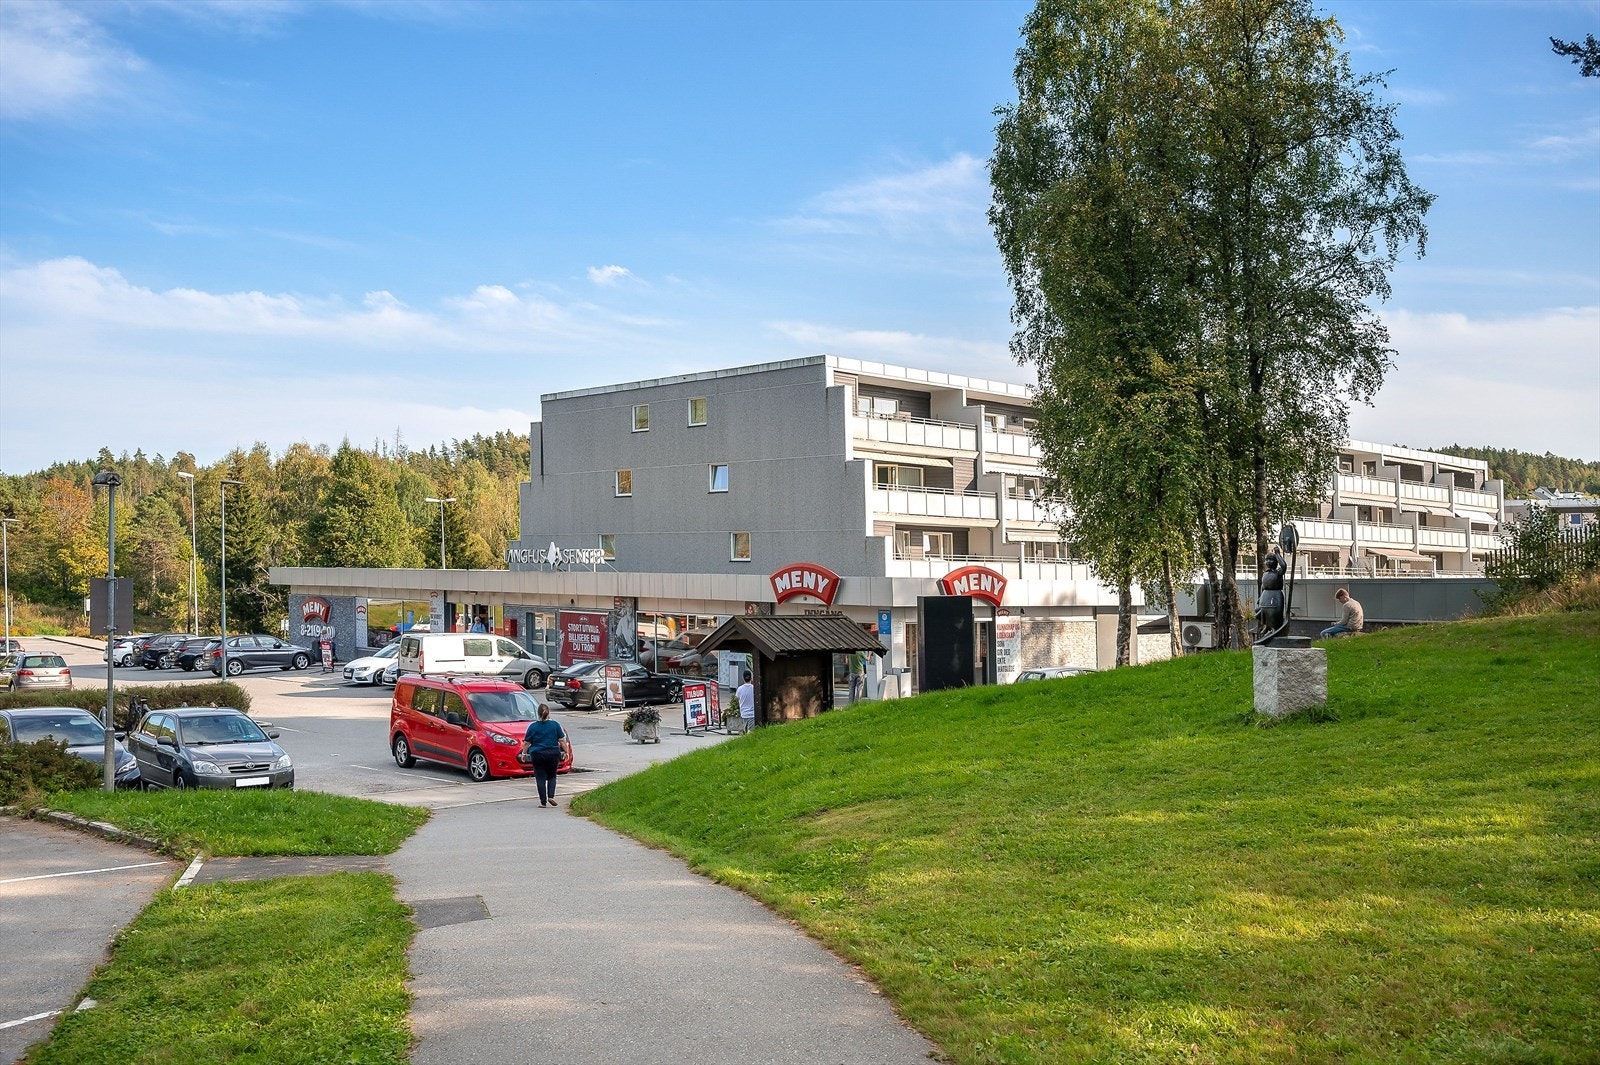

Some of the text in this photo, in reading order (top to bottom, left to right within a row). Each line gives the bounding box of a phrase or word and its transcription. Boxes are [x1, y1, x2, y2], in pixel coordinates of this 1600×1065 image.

[563, 548, 606, 564] SENTER
[774, 570, 830, 594] MENY
[952, 573, 1005, 596] MENY
[302, 601, 326, 616] MENY
[572, 642, 581, 651] DU
[686, 689, 704, 698] TILBUD
